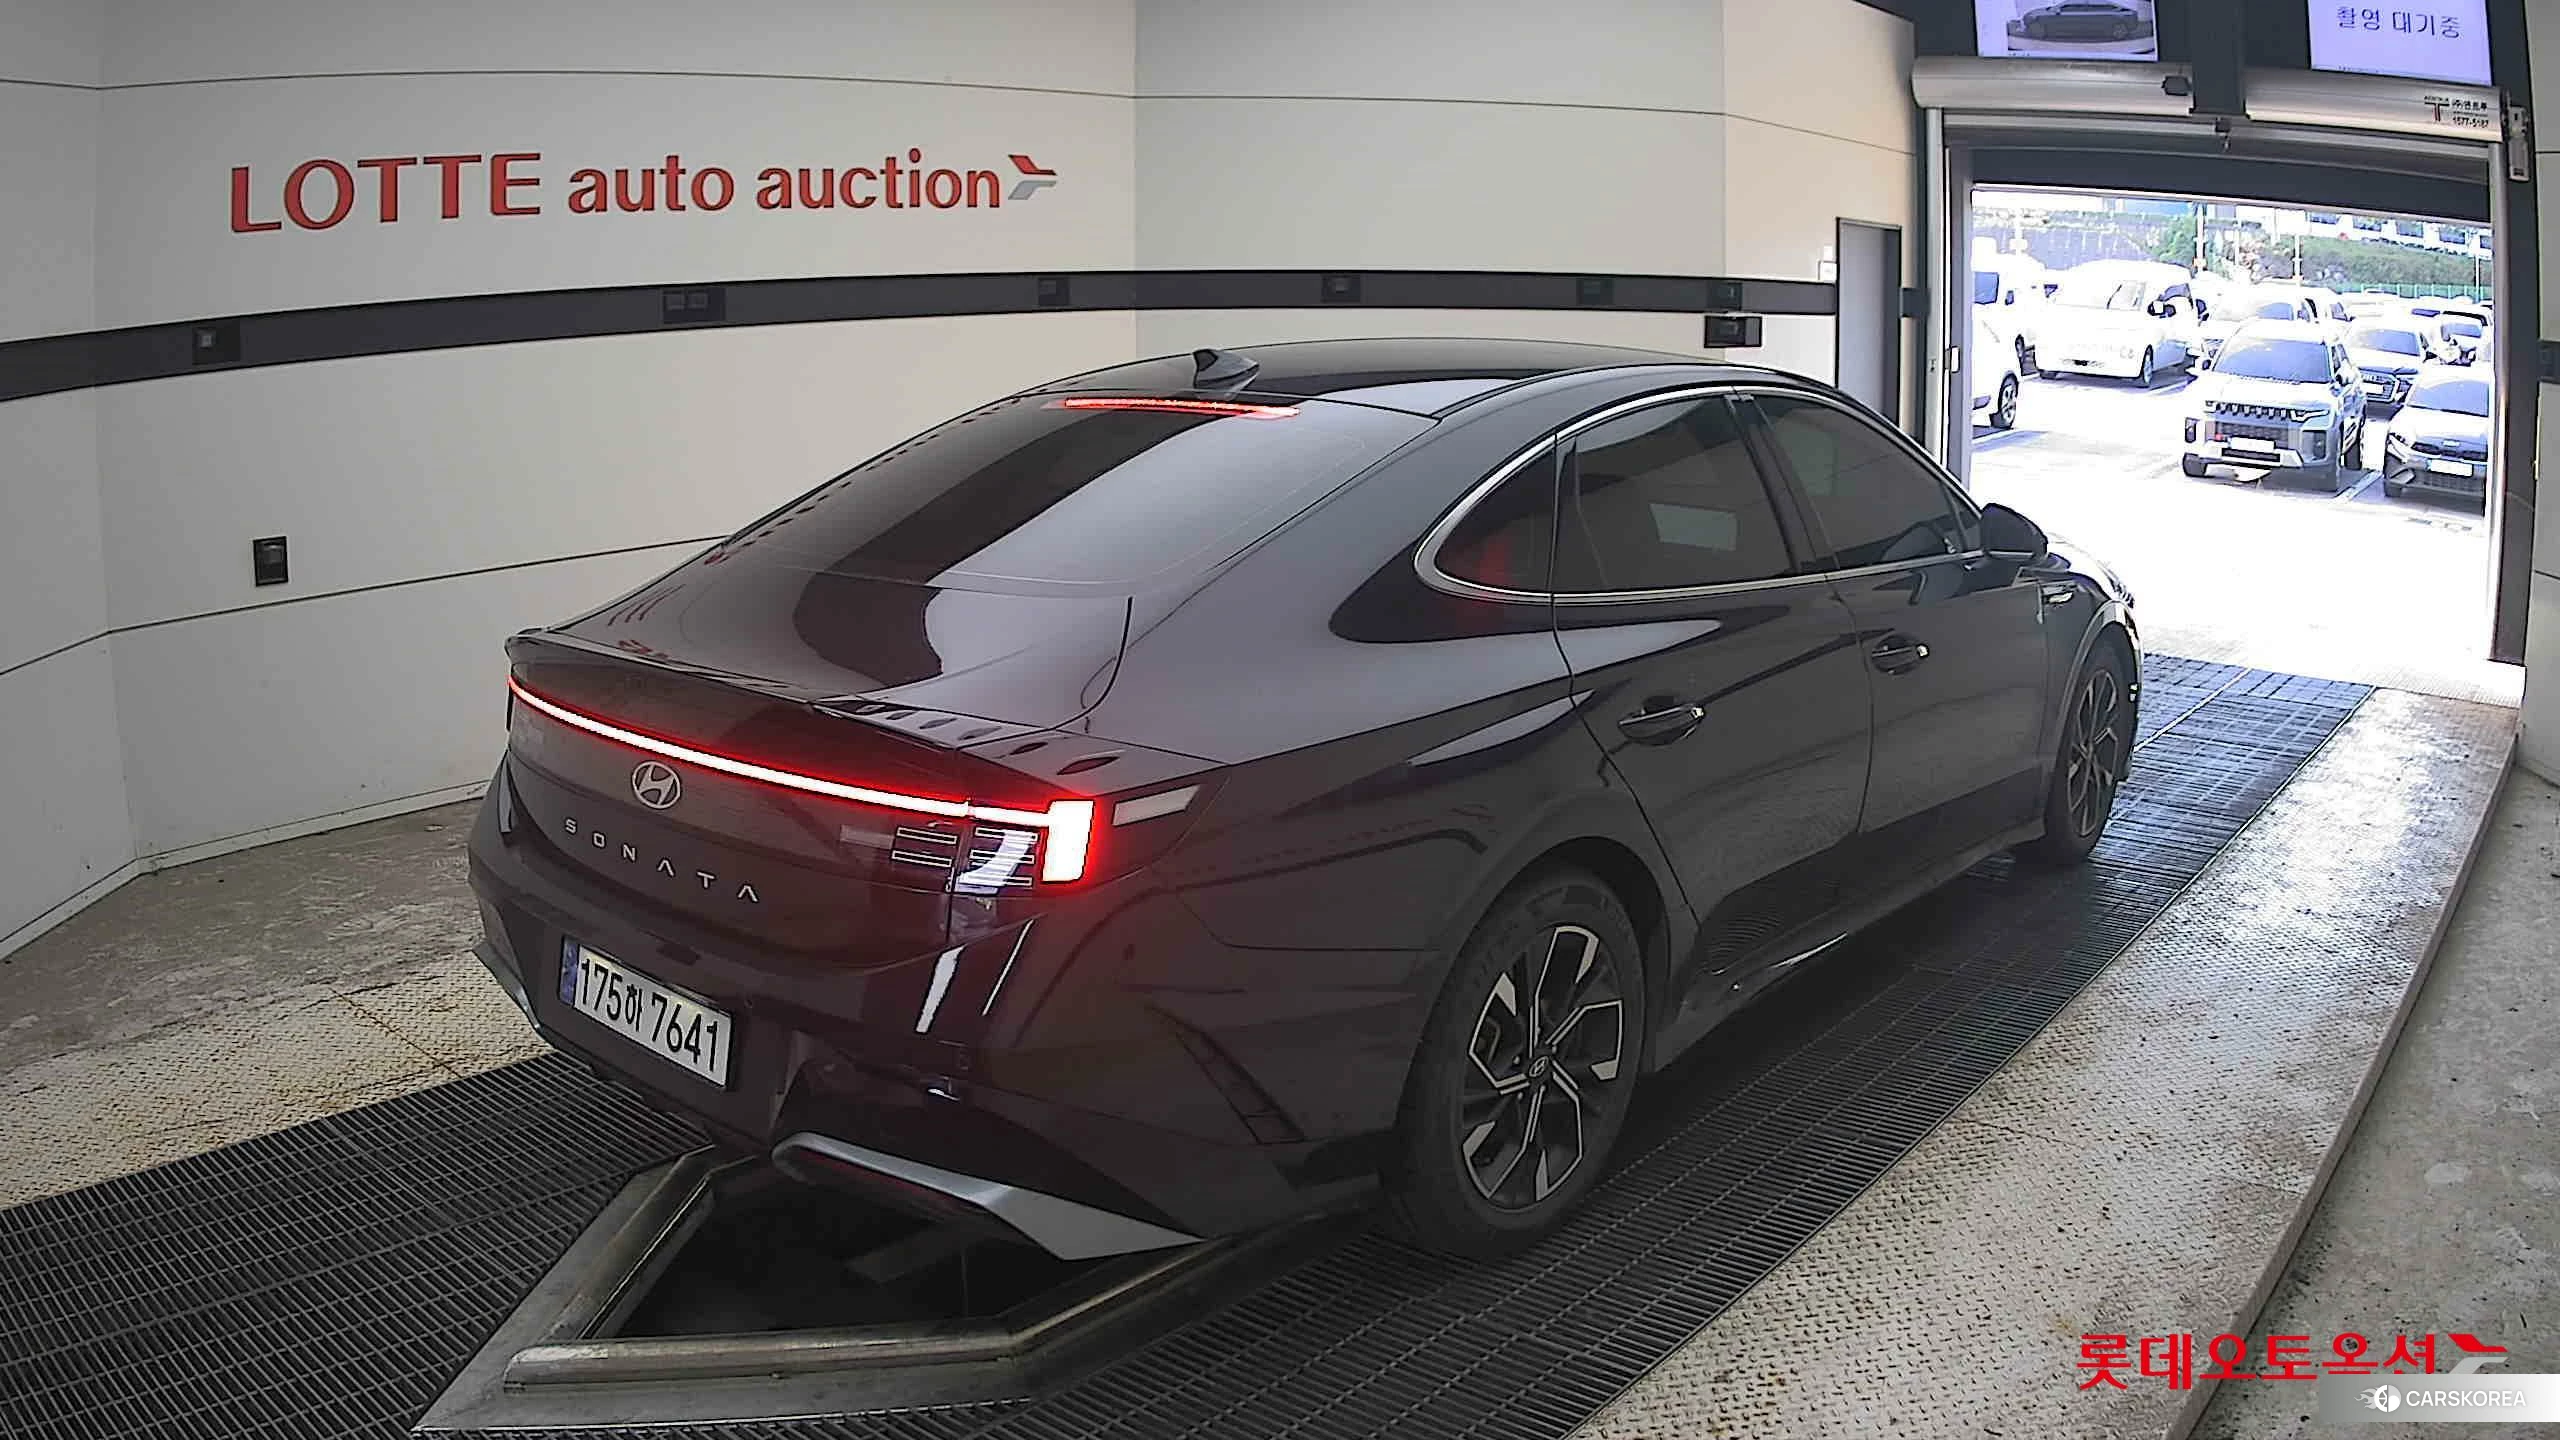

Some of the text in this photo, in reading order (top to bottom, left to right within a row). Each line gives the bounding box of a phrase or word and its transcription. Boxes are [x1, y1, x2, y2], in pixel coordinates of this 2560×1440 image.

[2337, 7, 2461, 39] 촬영 대기중
[231, 147, 1002, 233] LOTTE auto auction
[564, 818, 760, 902] SONATA
[581, 958, 718, 1072] 175하 7641
